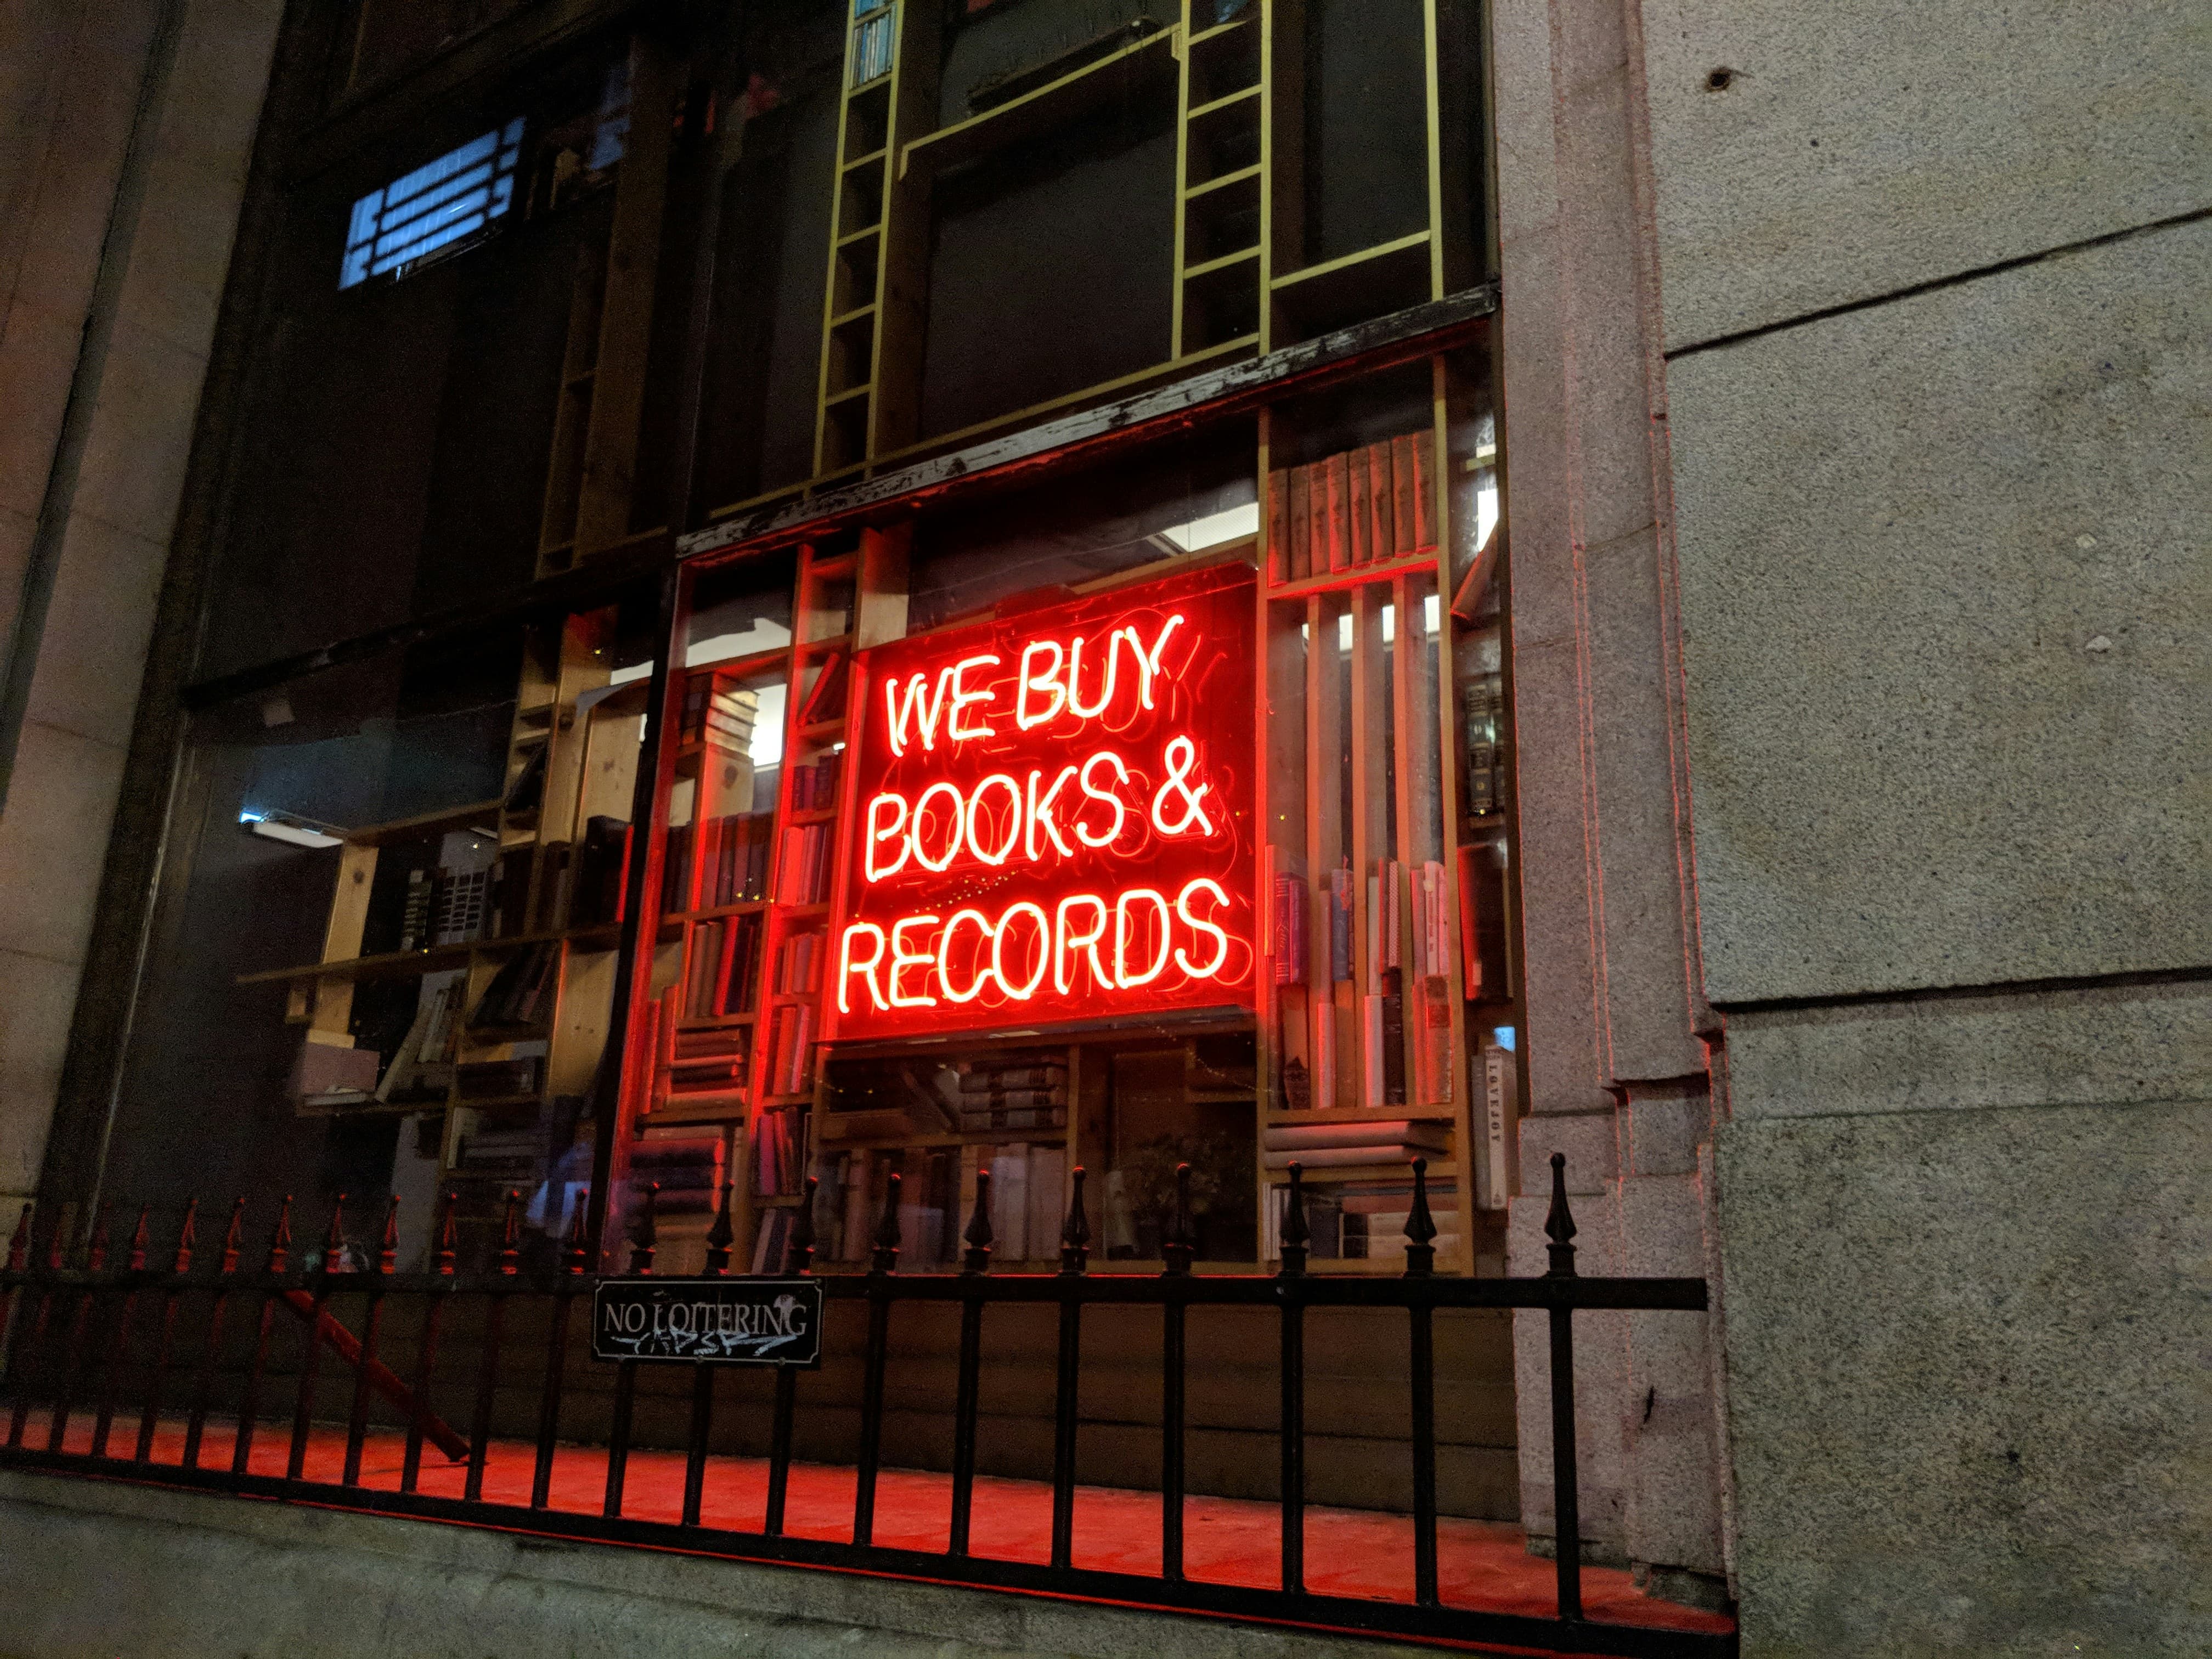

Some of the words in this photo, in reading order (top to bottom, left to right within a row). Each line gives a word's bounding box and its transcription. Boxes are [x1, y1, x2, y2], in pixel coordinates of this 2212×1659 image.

[885, 655, 1000, 757] WE
[1016, 614, 1184, 730] BUY
[865, 751, 1129, 882] BOOKS
[1151, 735, 1212, 836] &
[839, 878, 1230, 1013] RECORDS
[1488, 1064, 1501, 1142] LOVEJOY
[604, 1302, 646, 1333] NO
[653, 1302, 808, 1335] LOITERING
